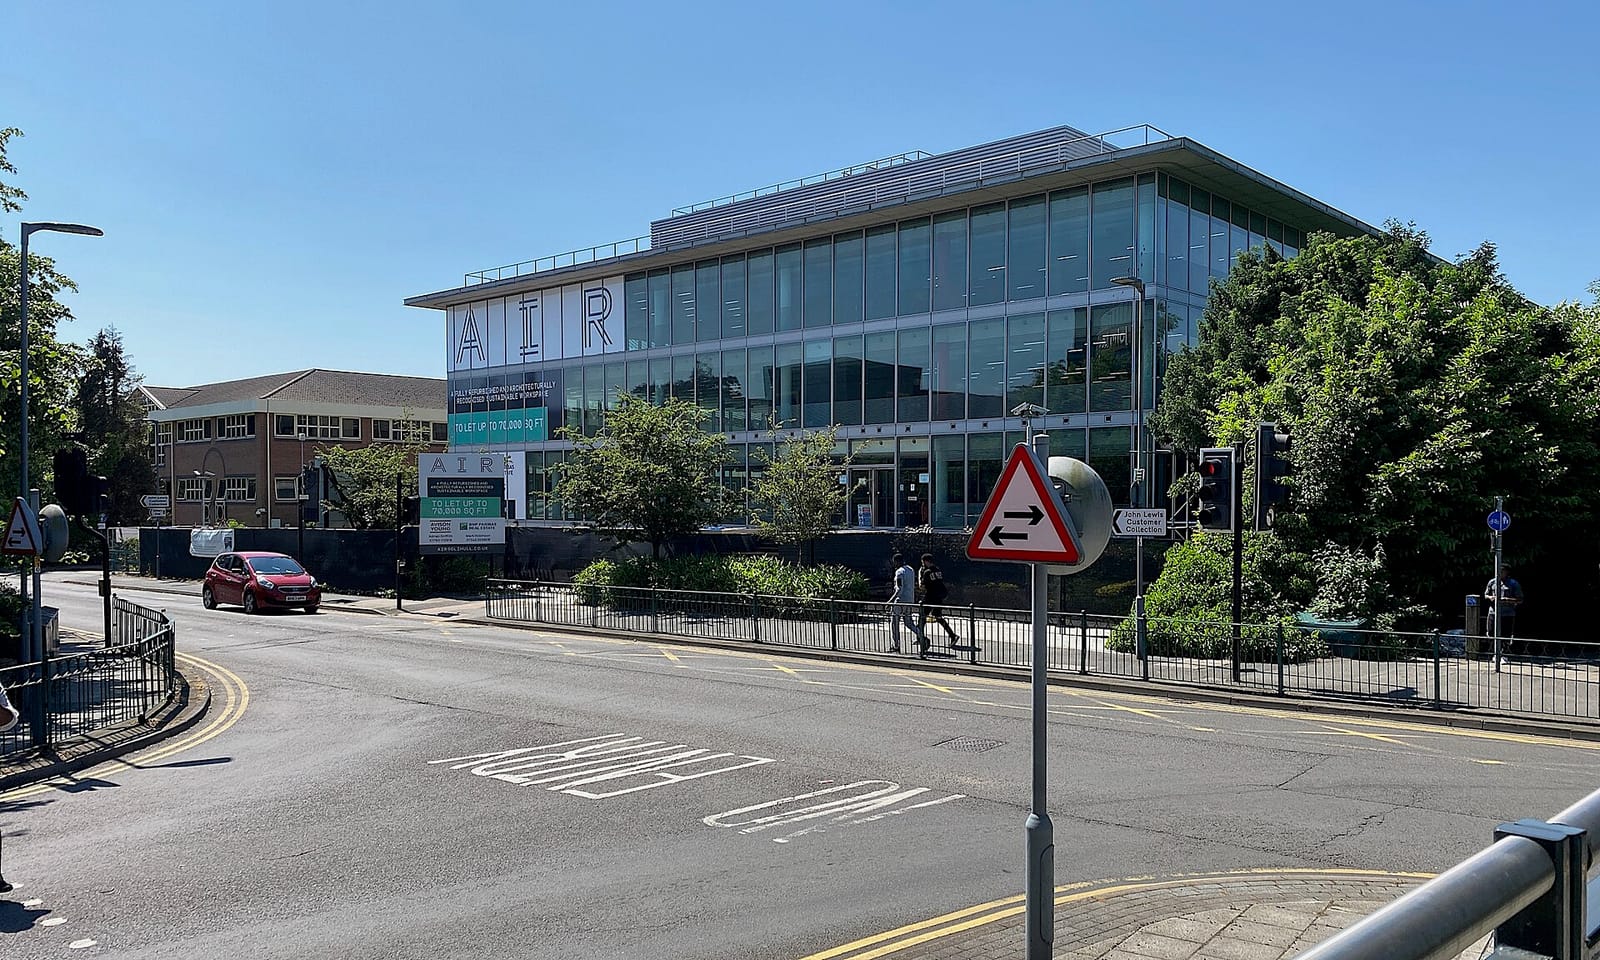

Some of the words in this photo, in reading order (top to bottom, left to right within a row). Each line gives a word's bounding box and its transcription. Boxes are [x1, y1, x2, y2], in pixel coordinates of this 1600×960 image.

[456, 287, 613, 364] AIR
[499, 385, 510, 393] AND
[519, 389, 549, 399] WRKSPAE
[455, 423, 463, 433] TO
[464, 422, 477, 432] LET
[477, 422, 487, 432] UP
[489, 421, 497, 431] TO
[498, 419, 523, 431] 70,000
[525, 418, 534, 431] SQ
[534, 418, 544, 428] FT
[430, 457, 494, 473] AIR
[463, 508, 475, 516] SQ
